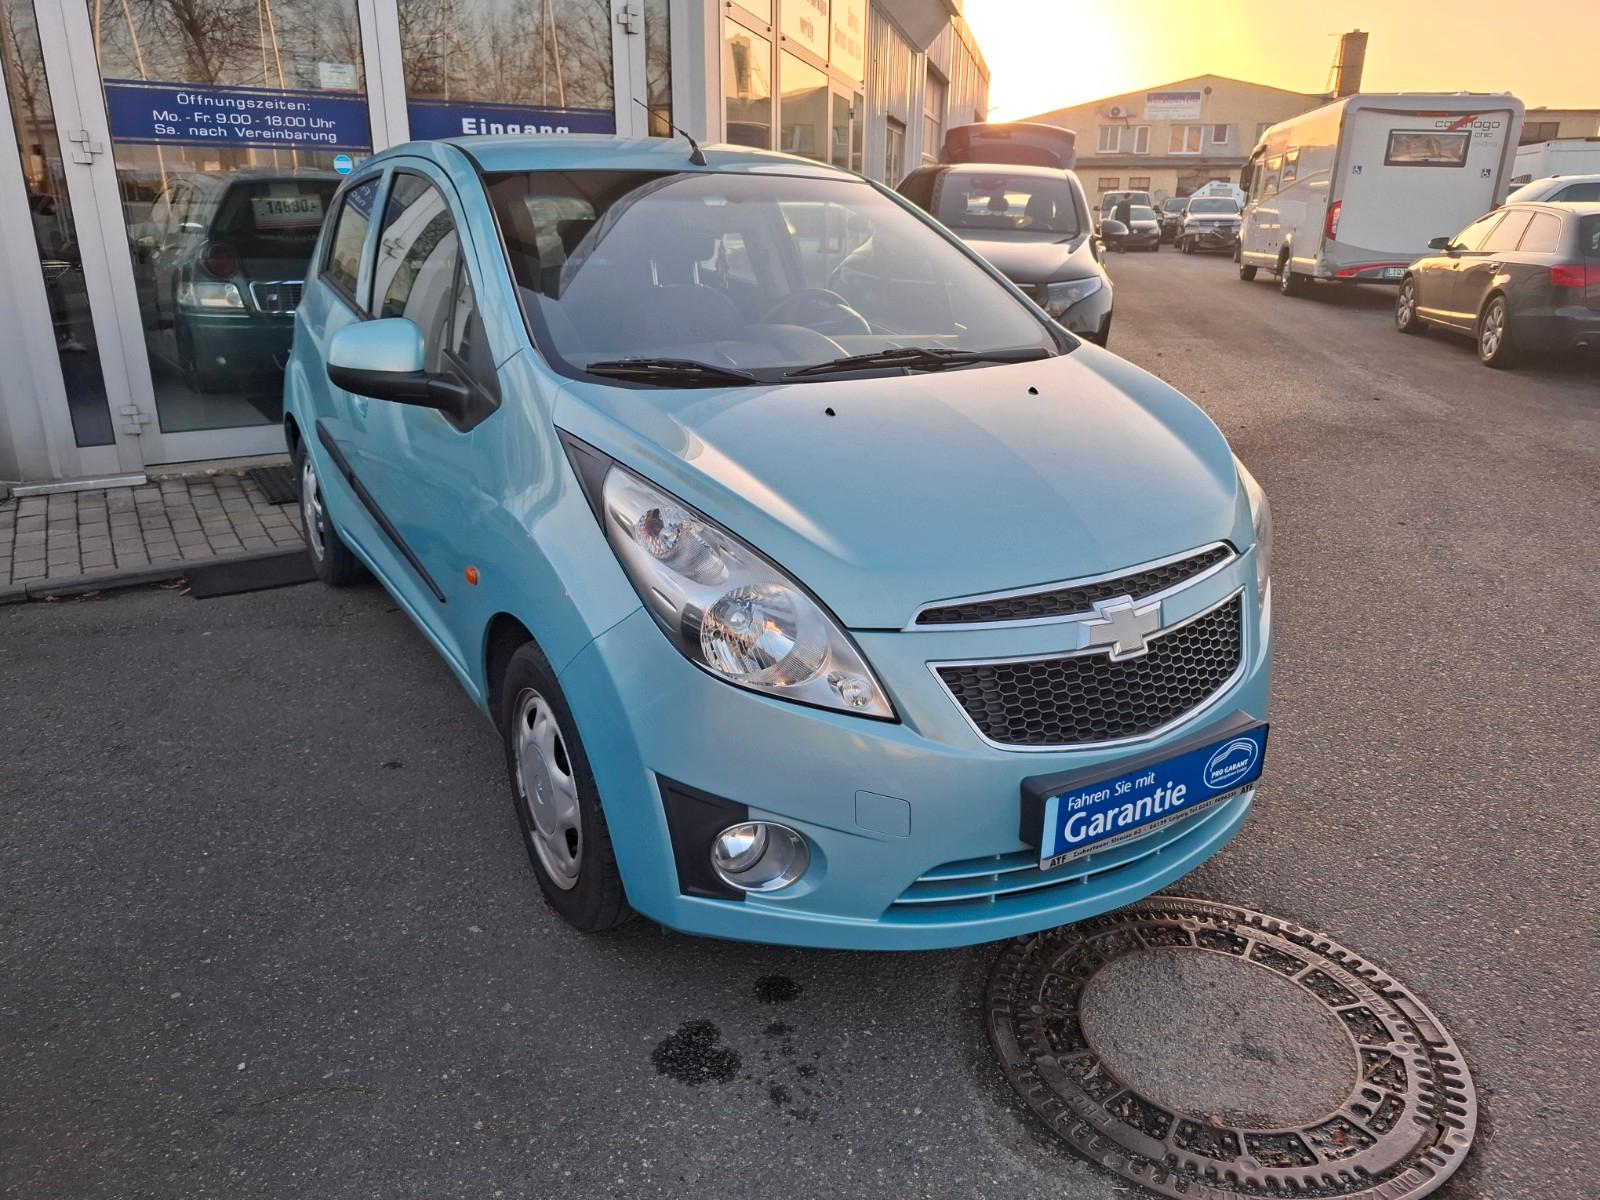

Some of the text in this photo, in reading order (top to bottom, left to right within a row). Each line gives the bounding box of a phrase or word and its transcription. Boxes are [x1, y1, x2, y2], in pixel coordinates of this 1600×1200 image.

[177, 92, 312, 112] Öffnungszeiten:
[153, 110, 182, 122] Mo.
[194, 112, 212, 124] Fr.
[216, 113, 252, 126] 9.00
[264, 115, 306, 128] 18.00
[310, 117, 336, 129] Uhr
[1435, 119, 1501, 131] cahago
[155, 123, 338, 144] Sa. nach Vereinbarung
[1211, 768, 1224, 779] PRO
[1224, 758, 1249, 775] GARANT
[1067, 771, 1156, 812] Fahren Sie mit
[1064, 780, 1187, 843] Garantie
[1050, 853, 1068, 868] ATF
[1240, 783, 1254, 796] ATF
